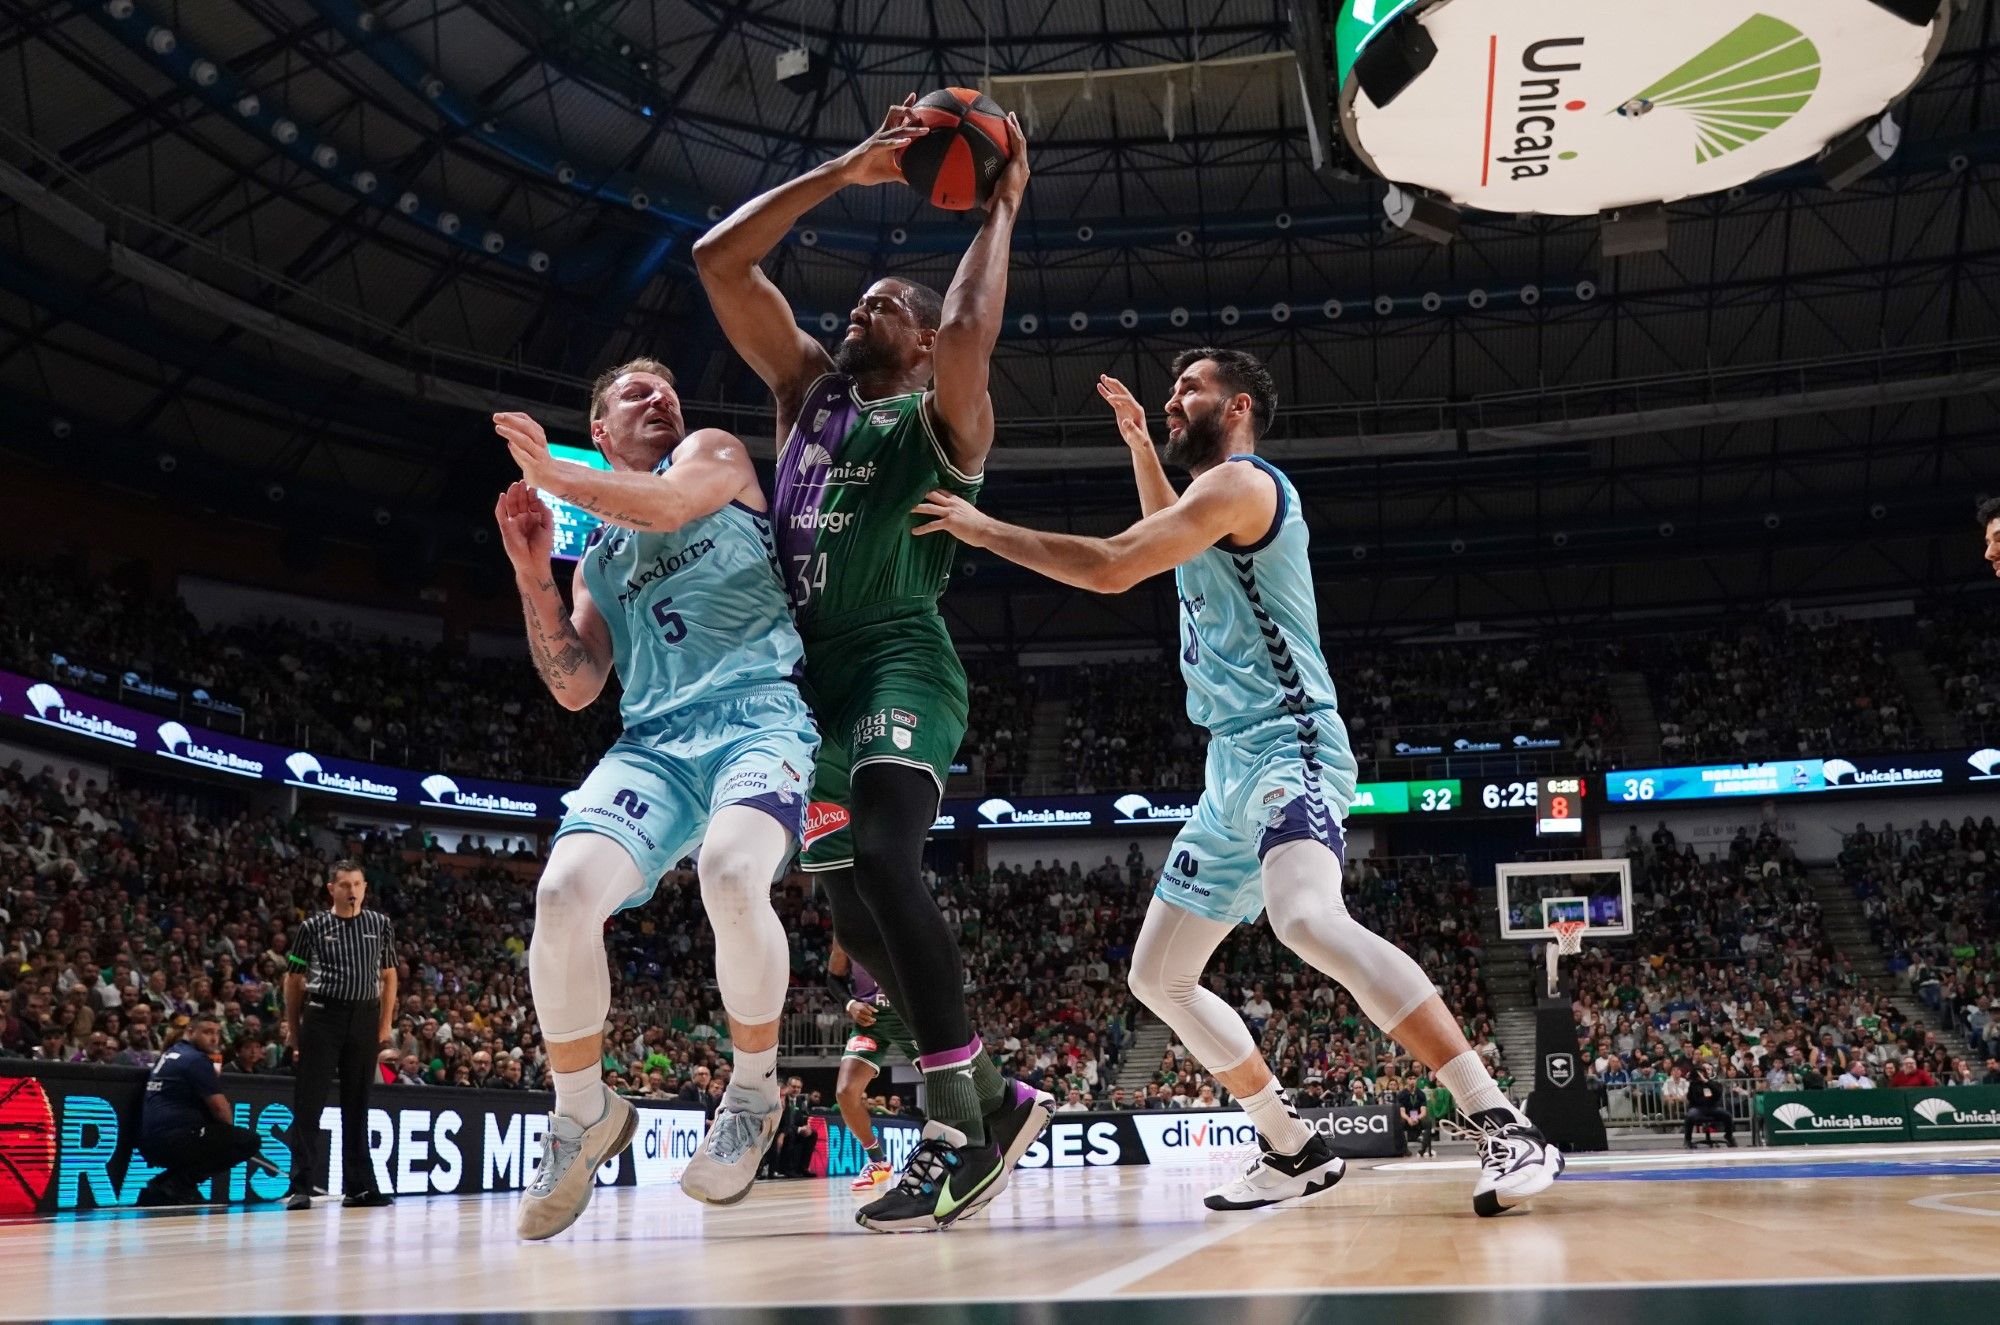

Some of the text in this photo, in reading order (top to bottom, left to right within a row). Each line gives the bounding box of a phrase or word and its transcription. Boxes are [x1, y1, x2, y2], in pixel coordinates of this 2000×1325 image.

[1496, 37, 1586, 180] Unicaja
[793, 552, 827, 606] 34
[652, 596, 687, 645] 5
[59, 708, 137, 741] Unicaja Banco
[187, 742, 263, 772] Unicaja Banco
[317, 773, 398, 796] Unicaja Banco
[1853, 768, 1943, 783] Unicaja Banco
[1420, 788, 1452, 811] 32
[1483, 782, 1538, 809] 6:25
[1622, 778, 1655, 801] 36
[454, 793, 536, 812] Unicaja Banco
[1148, 804, 1192, 818] Unicaja
[1551, 796, 1568, 818] 8
[936, 815, 955, 825] nco
[1011, 809, 1091, 823] Unicaja Banco
[1162, 1119, 1256, 1147] divina
[1300, 1112, 1389, 1135] ndesa
[1811, 1114, 1903, 1129] Unicaja Banco
